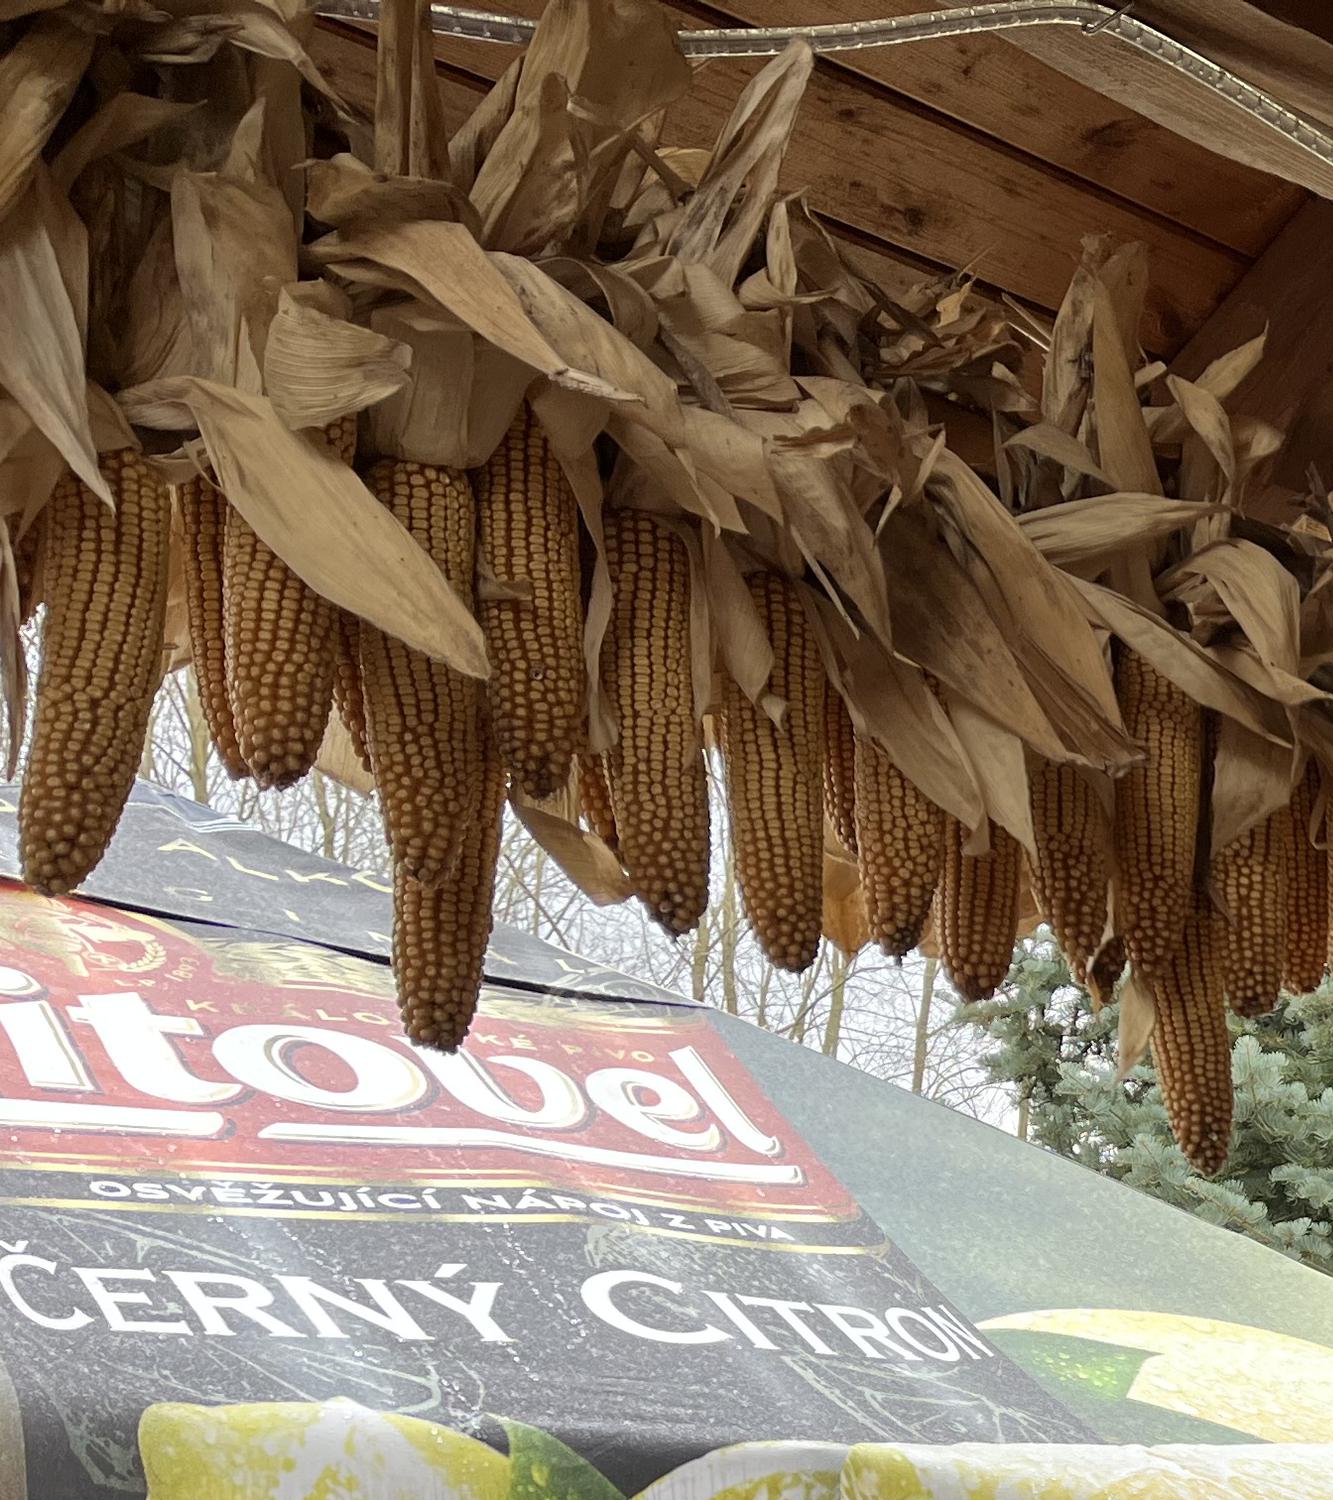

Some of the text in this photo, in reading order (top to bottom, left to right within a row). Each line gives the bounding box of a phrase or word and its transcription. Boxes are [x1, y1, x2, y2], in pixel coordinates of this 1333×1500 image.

[0, 963, 805, 1185] itovel
[461, 1188, 650, 1226] NÁPOJ
[659, 1212, 697, 1230] Z
[703, 1218, 797, 1241] PIVA
[0, 1239, 505, 1342] ČERNÝ
